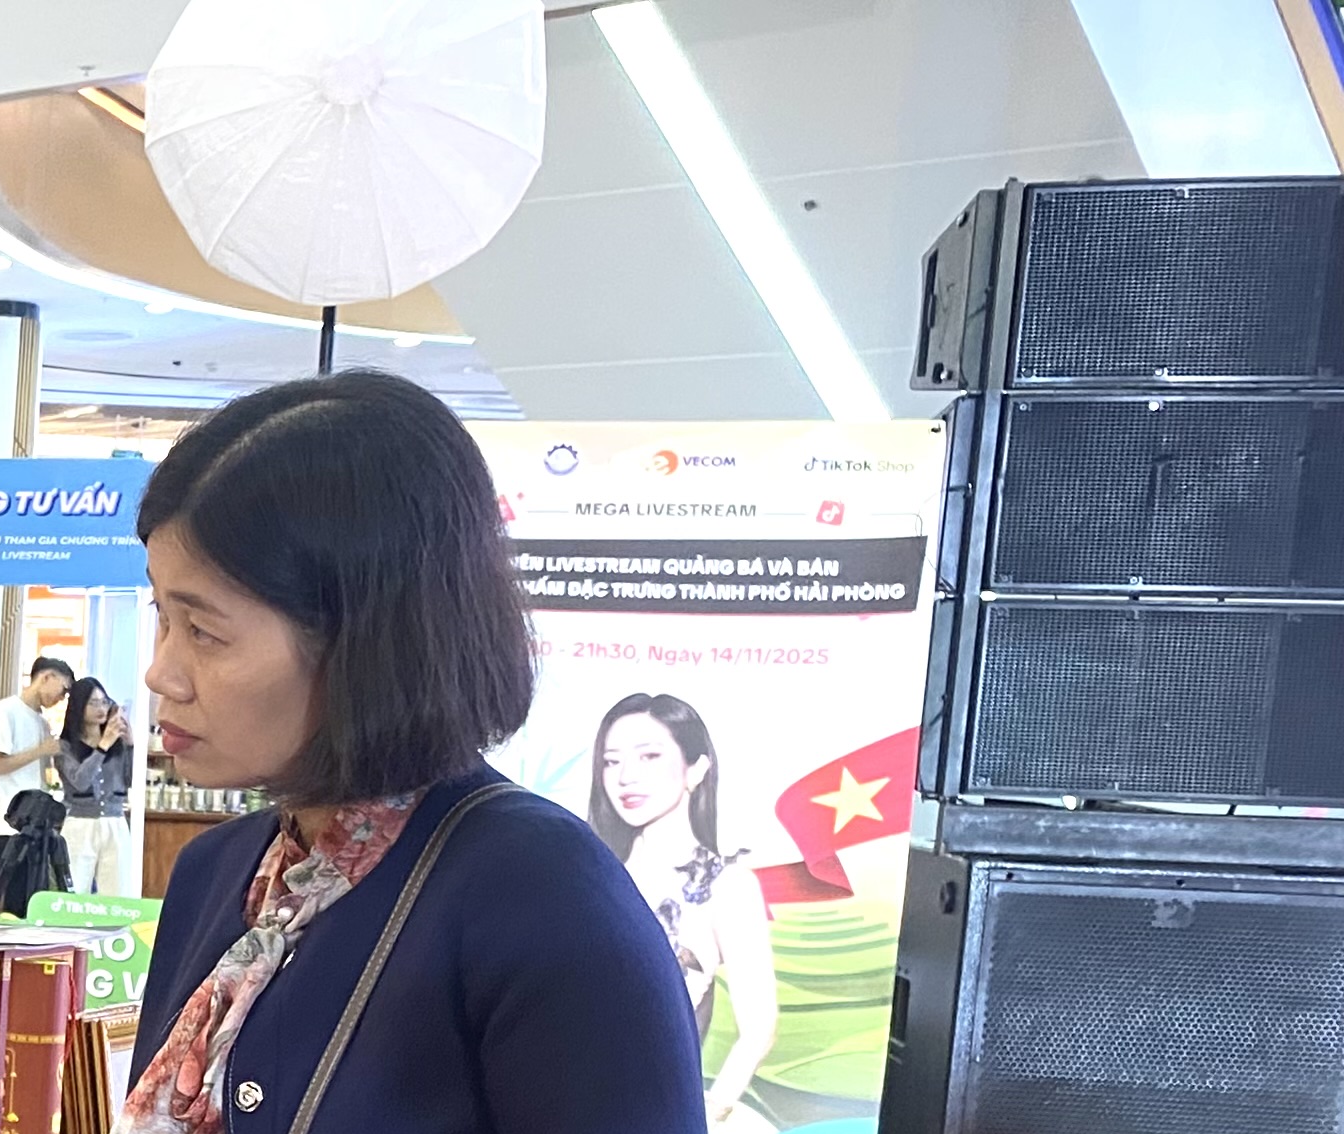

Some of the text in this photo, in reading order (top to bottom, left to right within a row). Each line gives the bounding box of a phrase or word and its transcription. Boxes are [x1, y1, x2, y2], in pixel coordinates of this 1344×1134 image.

[683, 456, 736, 467] VECOM
[877, 460, 915, 473] Shop
[14, 489, 60, 516] TƯ
[59, 481, 120, 516] VẤN
[575, 503, 757, 518] MEGA LIVESTREAM
[4, 536, 36, 545] THAM
[38, 536, 57, 545] GIA
[2, 552, 71, 561] LIVESTREAM
[546, 556, 661, 574] LIVESTREAM
[710, 647, 828, 664] 14/11/2025
[109, 905, 141, 920] Shop
